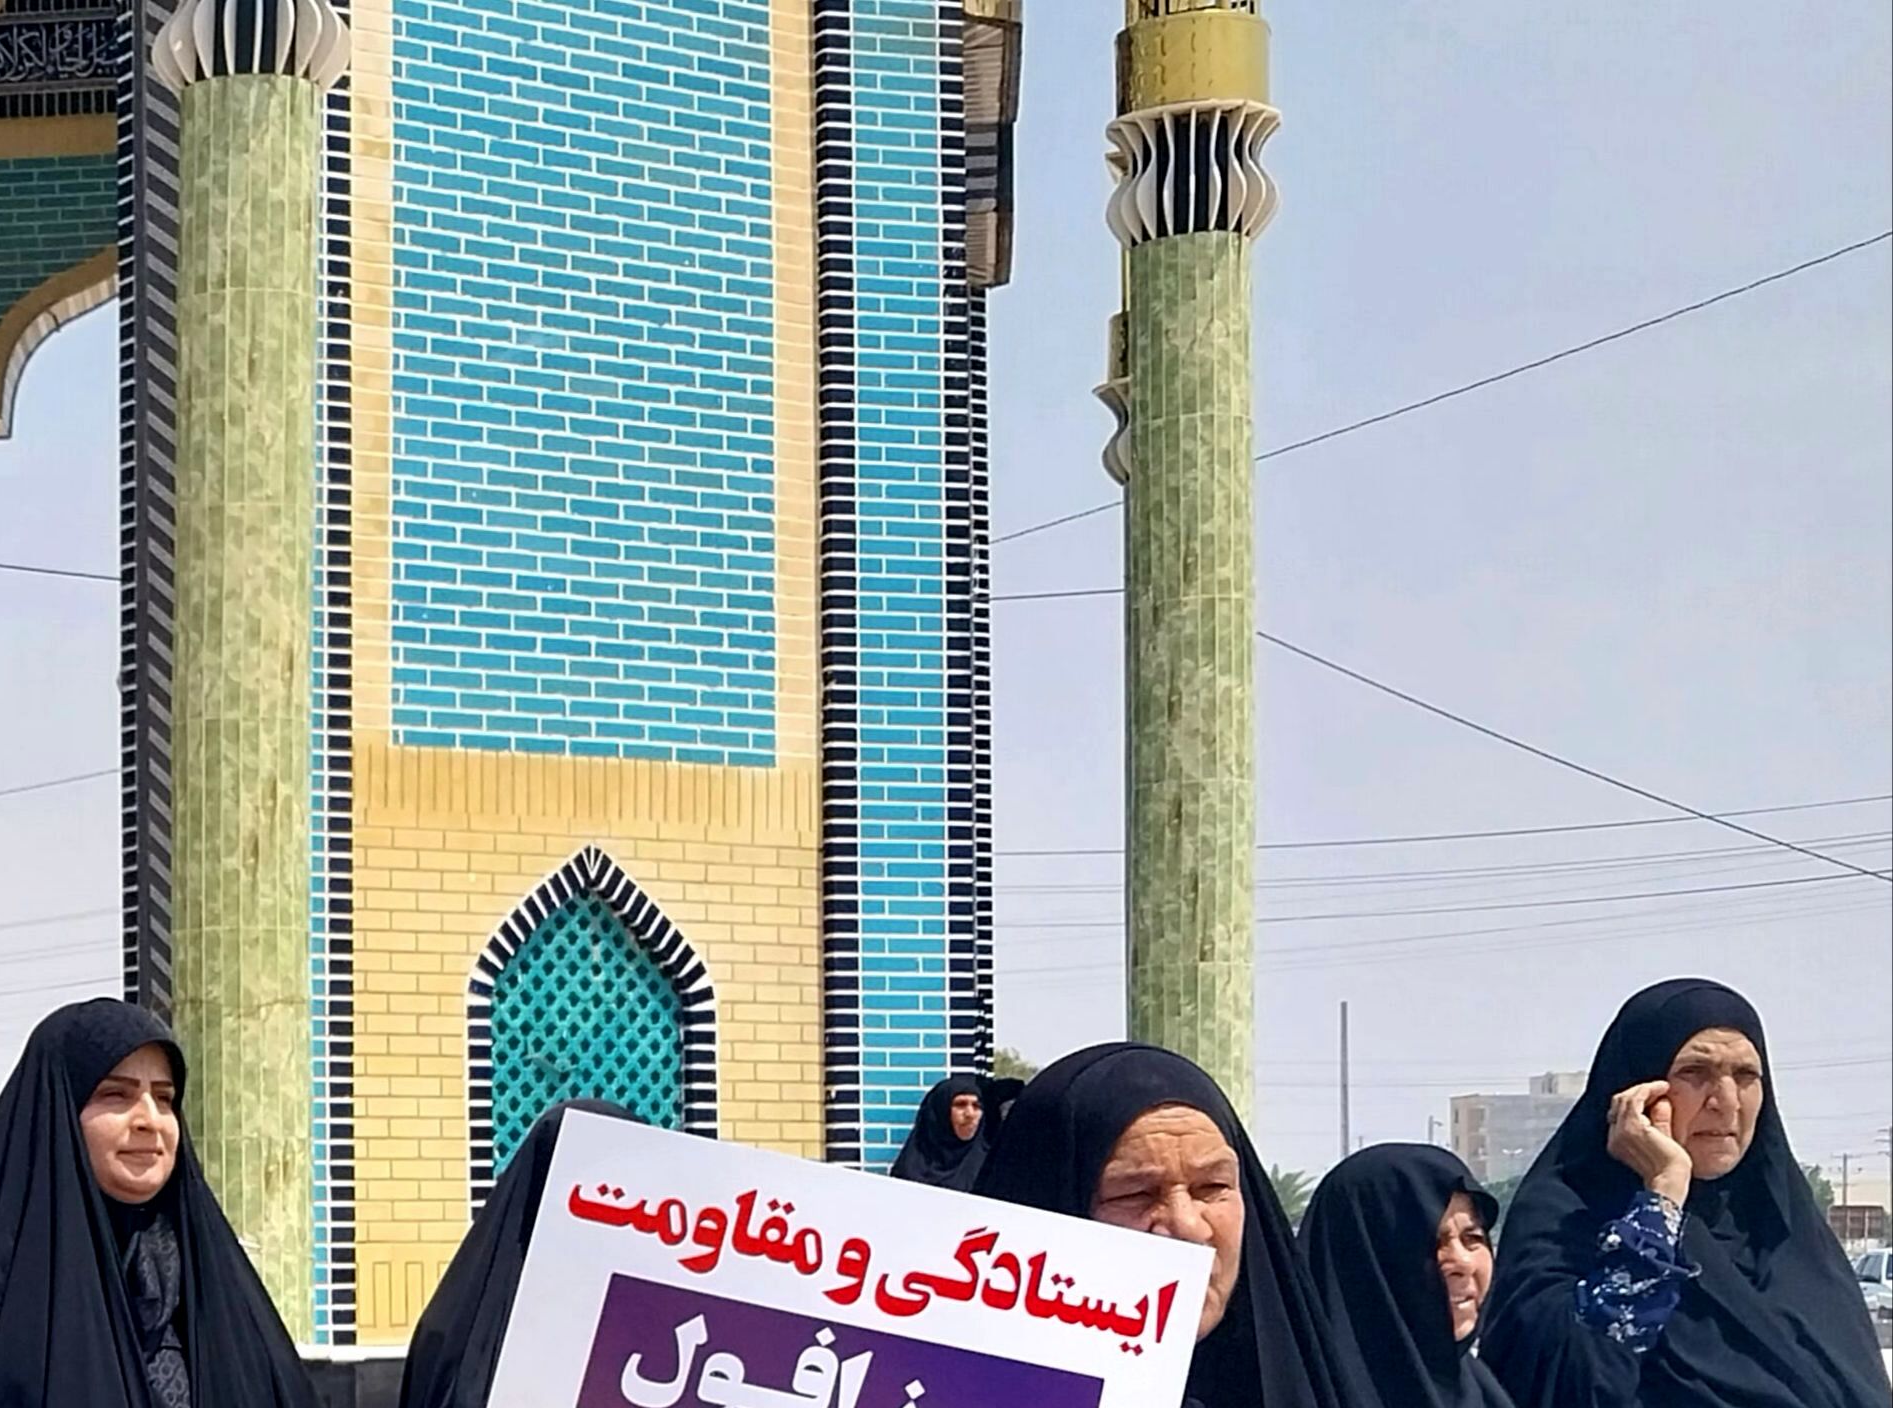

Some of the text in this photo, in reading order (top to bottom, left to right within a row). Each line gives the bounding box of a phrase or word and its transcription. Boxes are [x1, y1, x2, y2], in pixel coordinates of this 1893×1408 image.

[566, 1182, 1179, 1356] ایستادگی و مقاومت
